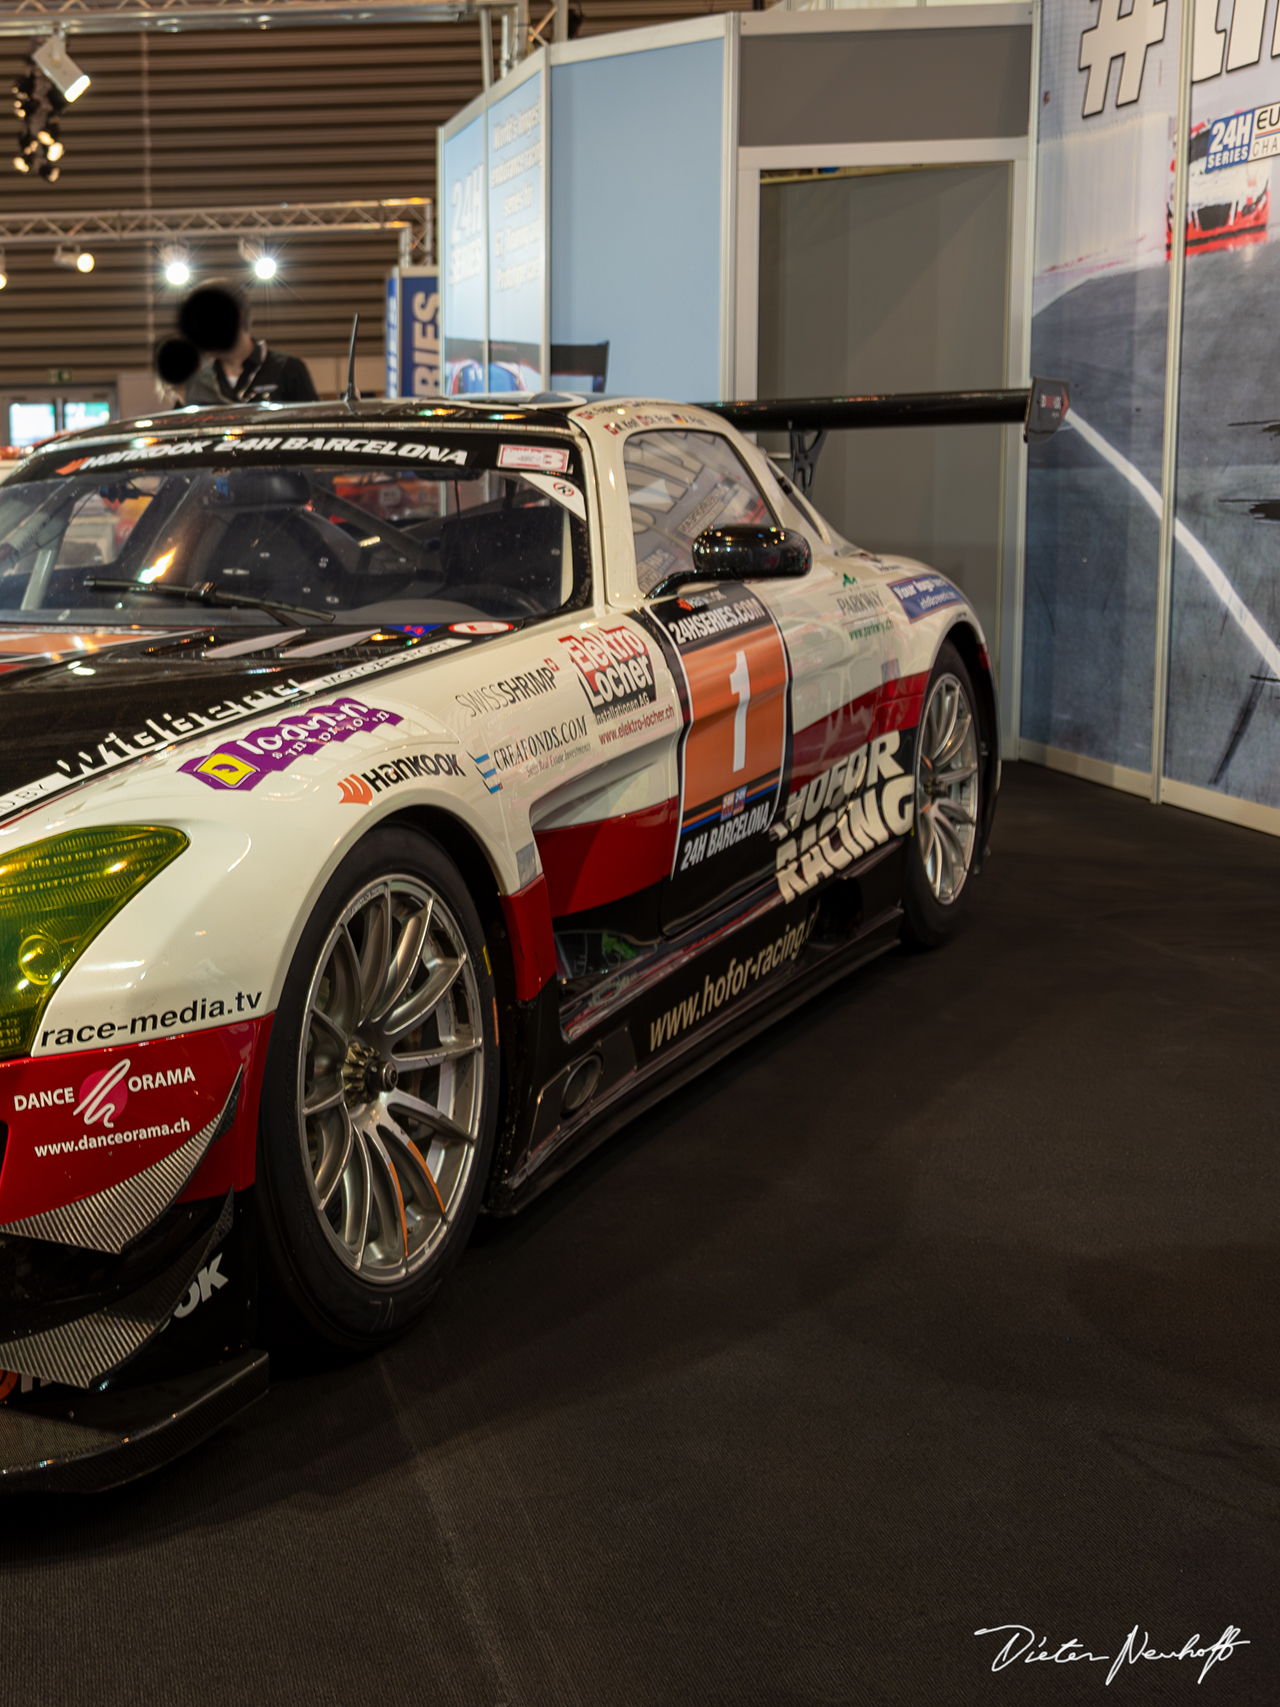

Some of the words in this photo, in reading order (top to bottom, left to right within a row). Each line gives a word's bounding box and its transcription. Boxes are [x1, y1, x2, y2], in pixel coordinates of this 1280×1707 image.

[1206, 145, 1249, 169] SERIES
[1209, 113, 1252, 154] 24H
[451, 164, 484, 246] 24H
[450, 237, 482, 285] SERIES
[214, 437, 284, 452] 24H
[280, 435, 468, 466] BARCELONA
[668, 598, 766, 645] 24HSERIES.COM
[559, 626, 645, 674] Elektro
[572, 655, 654, 708] Locher
[598, 703, 675, 746] www.elektro-locher.ch
[729, 650, 752, 773] 1
[493, 714, 588, 772] CREAFONDS.COM
[13, 780, 50, 805] BY
[680, 831, 709, 872] 24H
[706, 801, 770, 859] BARCELONA
[40, 991, 263, 1048] race-media.tv
[13, 1086, 75, 1112] DANCE
[127, 1065, 196, 1093] ORAMA
[34, 1116, 191, 1158] www.danceorama.ch
